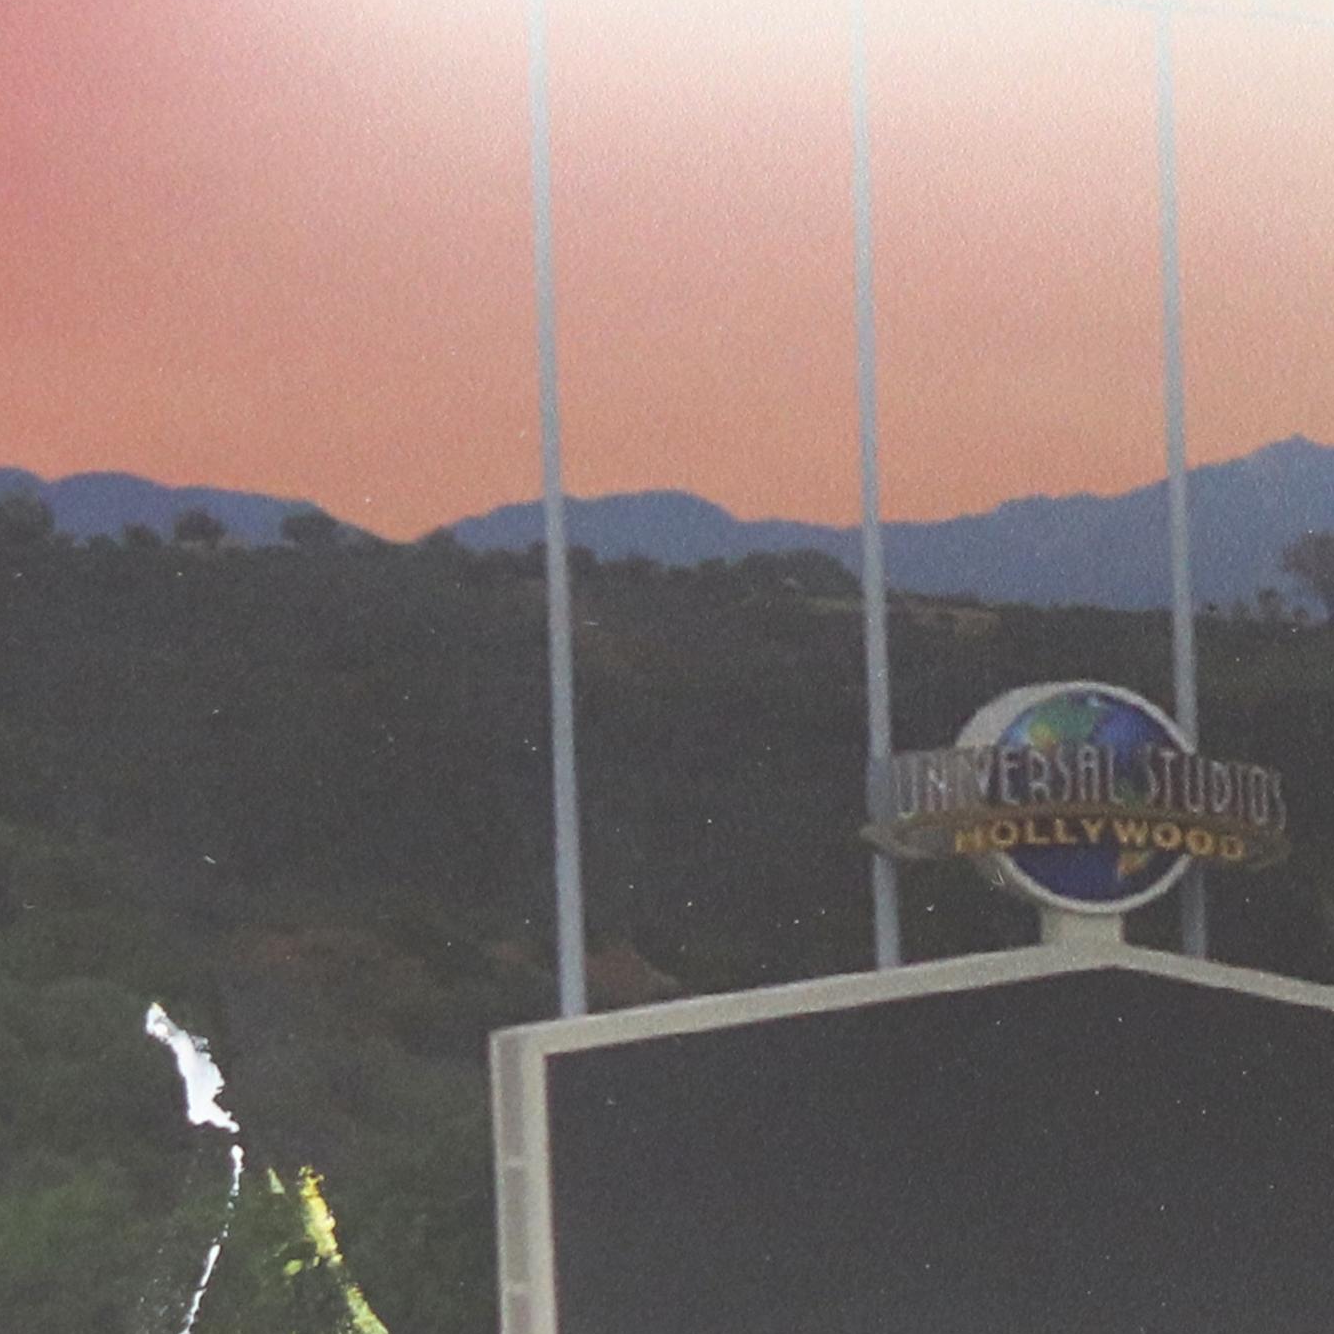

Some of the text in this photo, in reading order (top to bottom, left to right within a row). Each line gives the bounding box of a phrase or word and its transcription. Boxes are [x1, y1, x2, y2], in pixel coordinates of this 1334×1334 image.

[895, 742, 1287, 831] UNIVERSAL STUDIOS
[953, 816, 1246, 862] HOLLYWOOD
